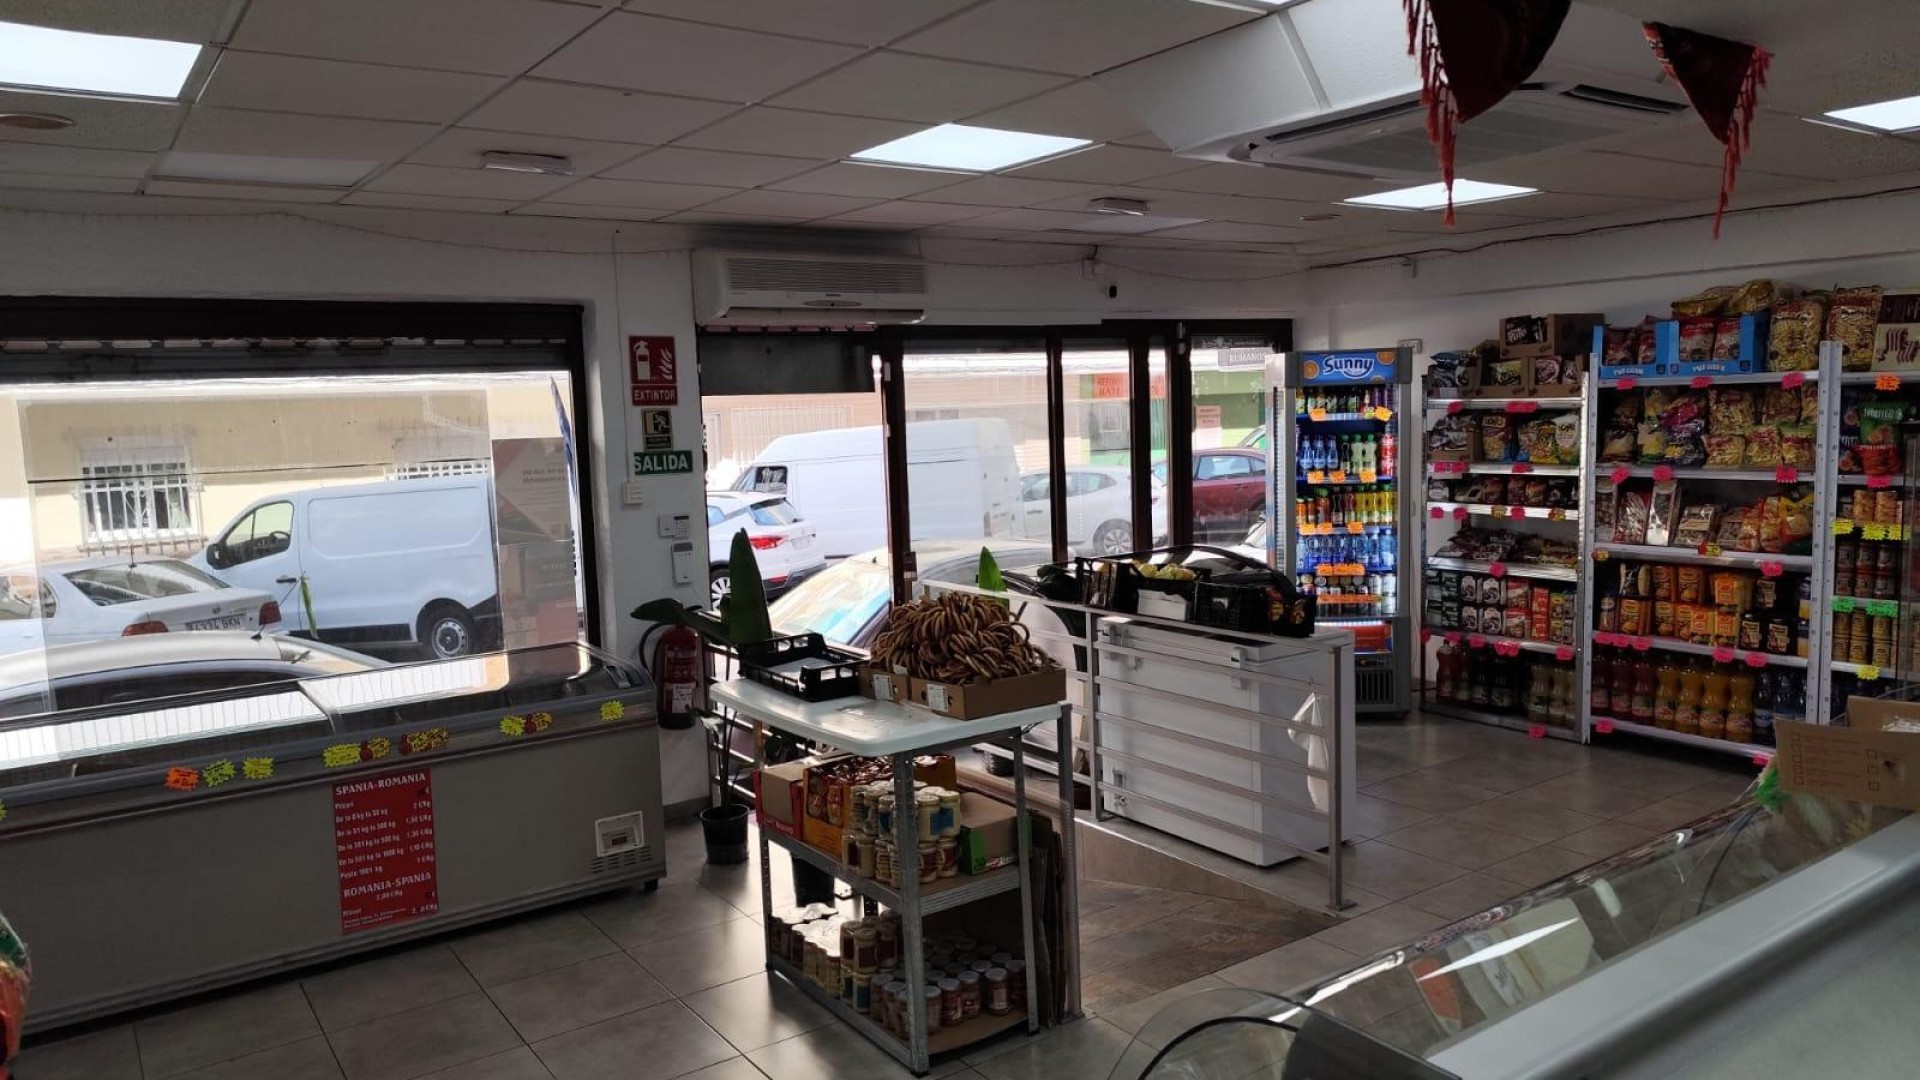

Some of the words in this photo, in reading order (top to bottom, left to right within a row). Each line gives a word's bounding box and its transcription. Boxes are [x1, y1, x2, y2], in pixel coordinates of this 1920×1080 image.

[1323, 355, 1375, 376] Sunny
[635, 390, 675, 402] EXTINTOR
[634, 453, 689, 473] SALIDA
[336, 772, 426, 795] SPANIA-ROMANIA
[343, 871, 431, 898] ROMANIA-SPANIA
